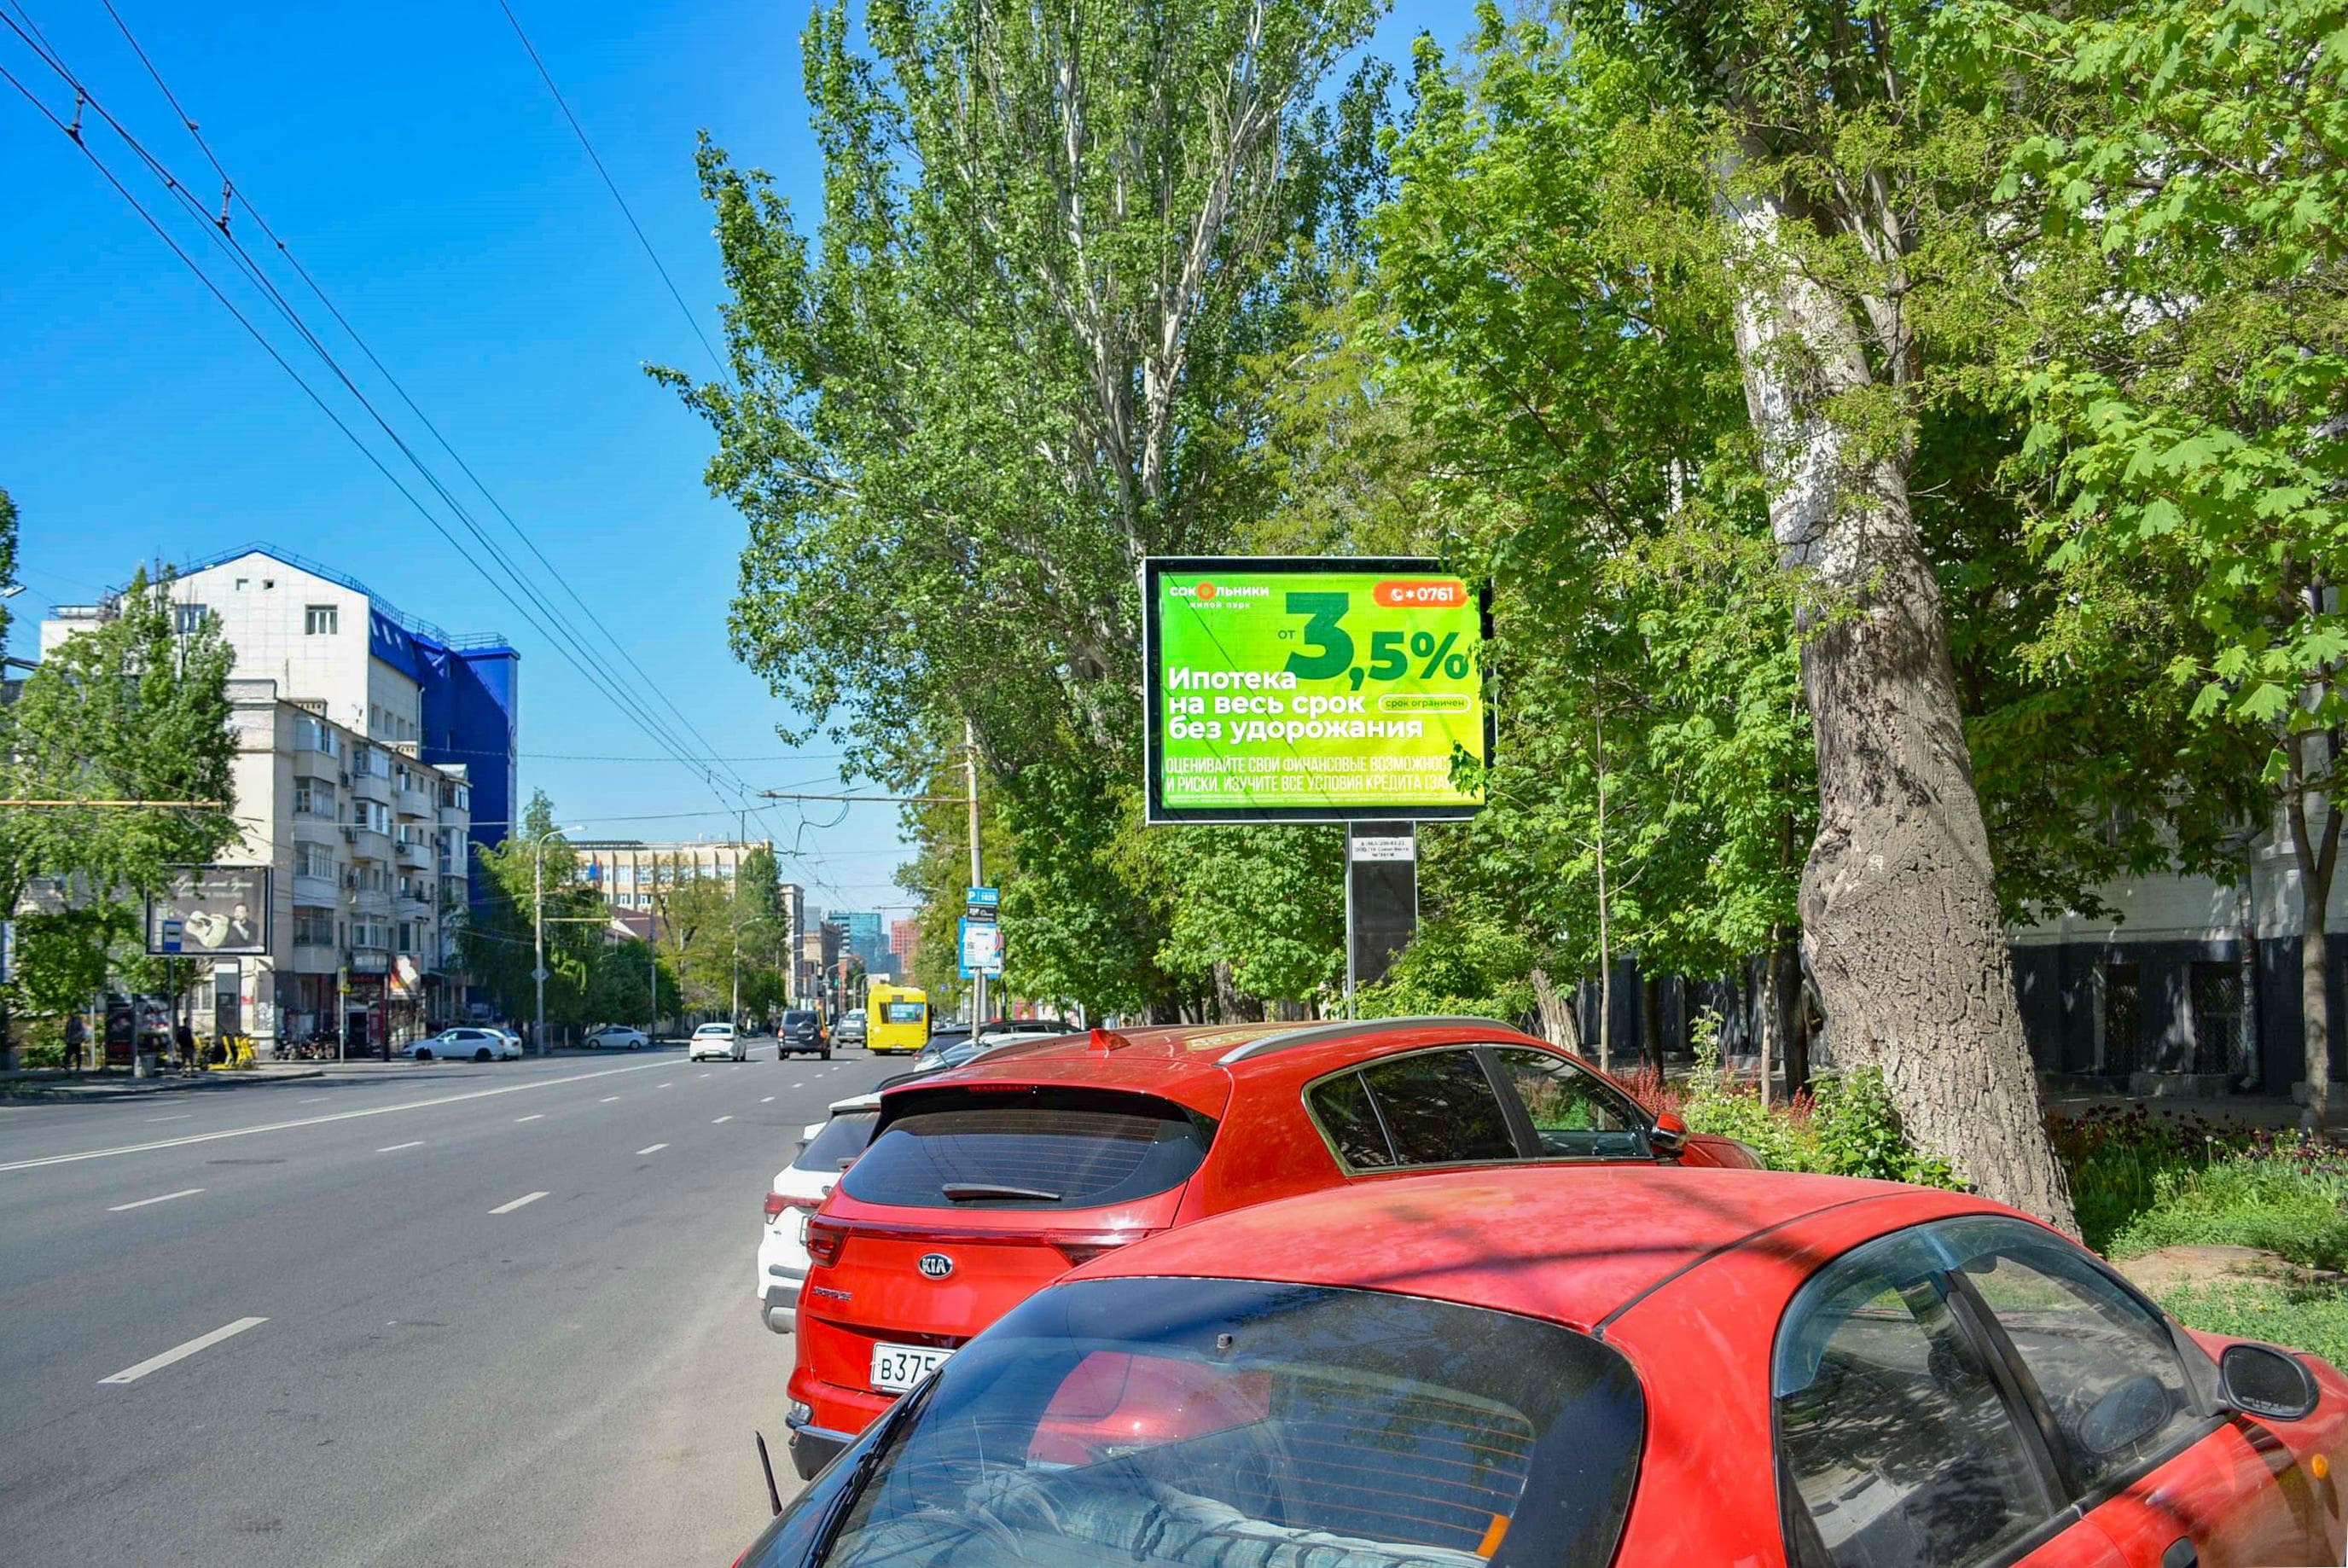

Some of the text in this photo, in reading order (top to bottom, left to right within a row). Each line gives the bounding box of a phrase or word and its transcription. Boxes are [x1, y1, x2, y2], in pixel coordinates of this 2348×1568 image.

[1284, 592, 1469, 691] 3,5%
[1168, 666, 1297, 690] Ипотека
[1169, 694, 1365, 719] на весь срок
[1385, 699, 1465, 709] срок ограничен
[1168, 715, 1424, 745] без удорожания
[1166, 755, 1245, 774] ОЦЕНИВАЙТЕ
[1248, 756, 1280, 773] СВОИ
[1283, 756, 1366, 772] ФИНАНСОВЫЕ
[1166, 775, 1174, 792] И
[1223, 775, 1279, 792] ИЗУЧИТЕ
[1282, 775, 1305, 792] ВСЕ
[1308, 775, 1363, 792] УСЛОВИЯ
[1366, 774, 1421, 792] КРЕДИТА
[922, 1258, 946, 1274] KIA
